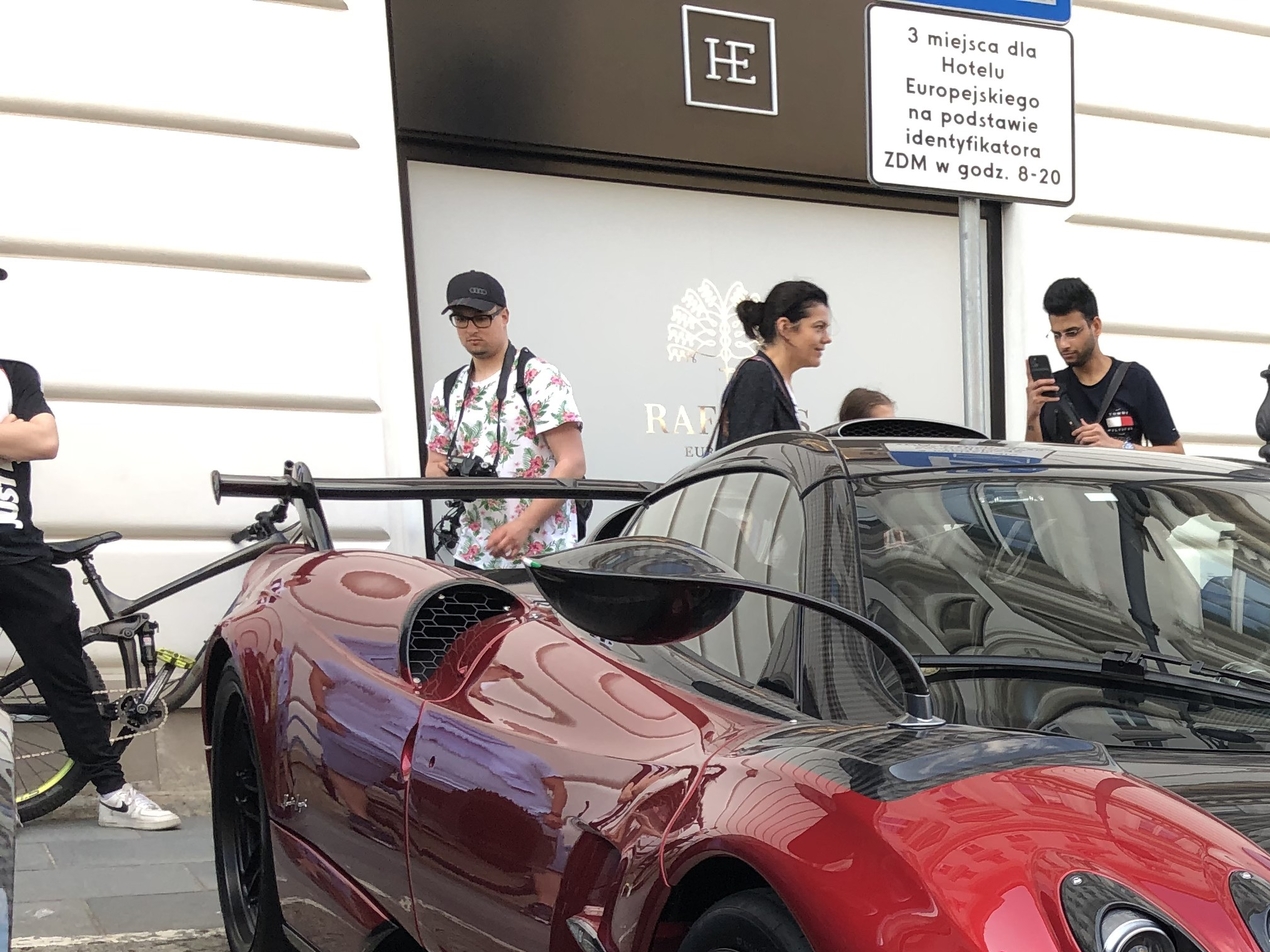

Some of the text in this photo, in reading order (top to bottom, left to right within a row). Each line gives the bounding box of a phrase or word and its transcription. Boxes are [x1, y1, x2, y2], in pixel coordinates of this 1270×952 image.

[908, 27, 1037, 59] 3 miejsca dla
[704, 37, 756, 85] HE
[942, 56, 1005, 79] Hotelu
[906, 77, 1040, 111] Europejskiego
[909, 107, 1038, 133] na podstawie
[906, 128, 1041, 158] identyfikatora
[884, 151, 1061, 185] ZDM w godz. 8-20
